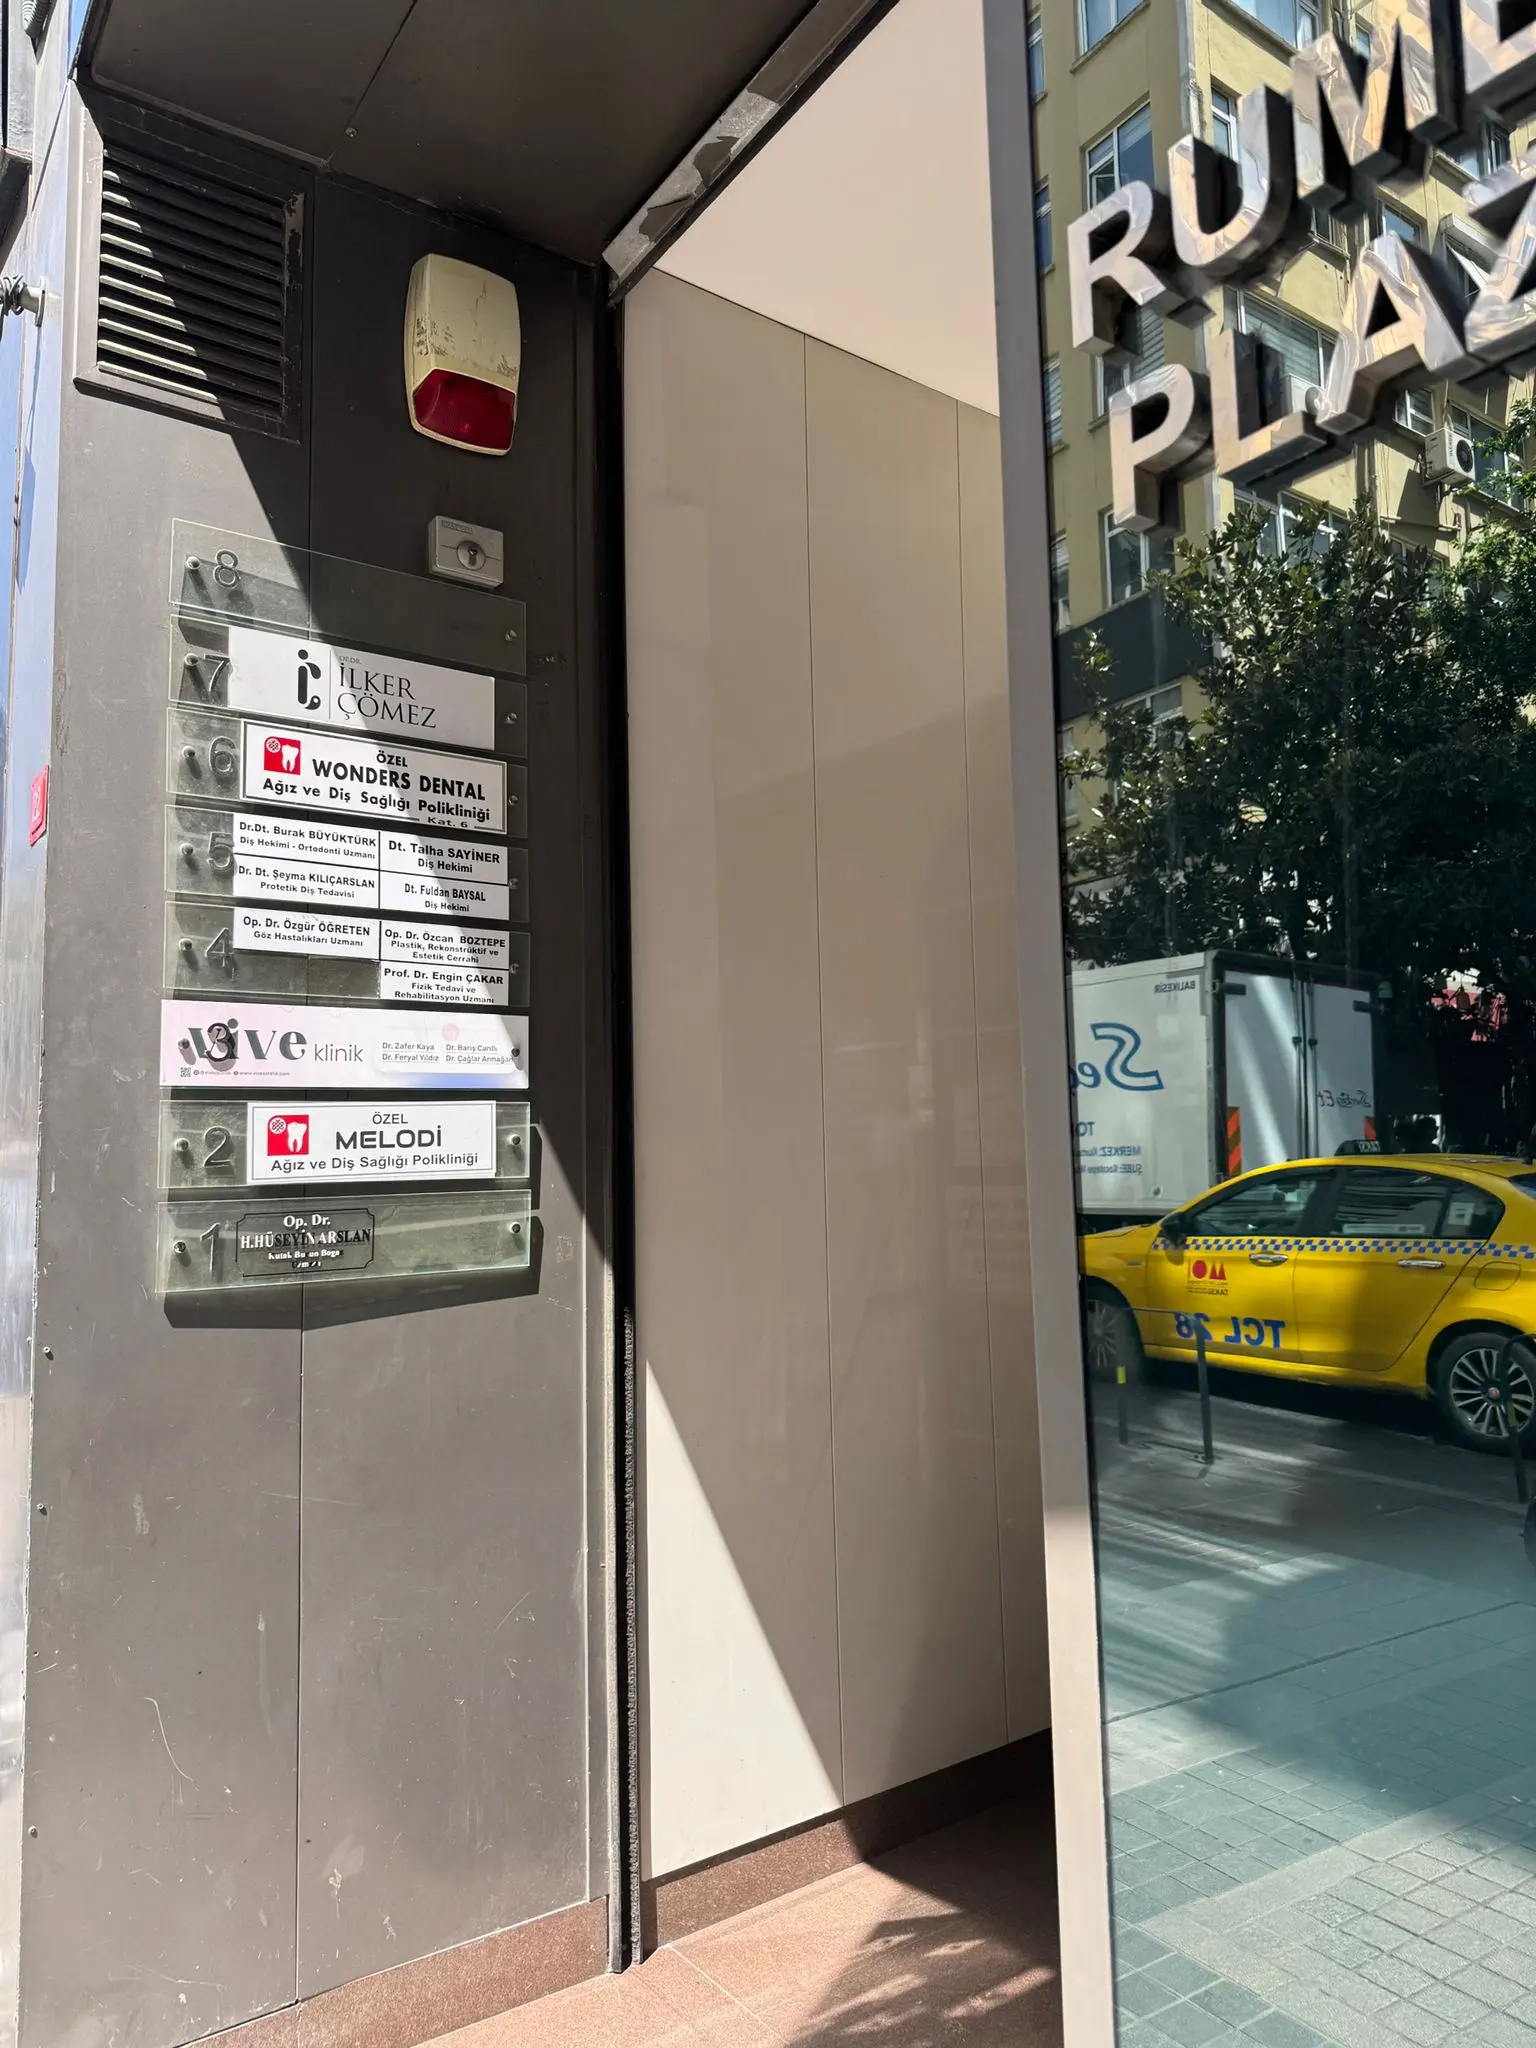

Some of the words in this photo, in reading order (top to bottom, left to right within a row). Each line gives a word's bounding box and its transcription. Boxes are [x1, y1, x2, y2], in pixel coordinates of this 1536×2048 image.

[213, 549, 241, 589] 8
[204, 653, 233, 693] 7
[340, 662, 416, 700] İLKER
[338, 692, 436, 728] ÇÖMEZ
[208, 736, 235, 773] 6
[376, 750, 408, 767] ÖZEL
[312, 758, 411, 790] WONDERS
[419, 775, 485, 801] DENTAL
[263, 778, 297, 795] Ağız
[303, 786, 320, 797] ve
[329, 787, 351, 803] Diş
[360, 791, 410, 811] Sağlığı
[418, 799, 490, 822] Polikliniği
[428, 816, 456, 827] Kat.
[239, 822, 270, 834] Dr.Dt.
[274, 826, 305, 838] Burak
[309, 829, 377, 847] BÜYÜKTÜRK
[207, 832, 233, 869] 5
[240, 837, 255, 846] Diş
[257, 838, 290, 849] Hekimi
[298, 843, 341, 856] Ortodonti
[343, 849, 376, 860] Uzmanı
[388, 840, 406, 852] Dt.
[410, 843, 444, 857] Talha
[447, 847, 500, 864] SAYİNER
[418, 858, 434, 870] Diş
[437, 860, 473, 873] Hekimi
[238, 865, 252, 875] Dr.
[255, 867, 270, 877] Dt.
[272, 869, 306, 882] Şeyma
[309, 873, 375, 889] KILIÇARSLAN
[260, 881, 298, 893] Protetik
[300, 885, 315, 896] Diş
[318, 887, 355, 899] Tedavisi
[404, 883, 417, 894] Dt.
[420, 885, 450, 898] Fuldan
[452, 889, 486, 902] BAYSAL
[424, 900, 438, 910] Diş
[440, 902, 470, 912] Hekimi
[243, 916, 261, 928] Op.
[265, 918, 280, 928] Dr.
[283, 919, 315, 934] Özgür
[318, 921, 370, 936] ÖĞRETEN
[205, 927, 235, 967] 4
[253, 931, 272, 940] Göz
[274, 932, 328, 944] Hastalıkları
[330, 937, 364, 947] Uzmanı
[384, 929, 402, 940] Op.
[405, 931, 419, 941] Dr.
[422, 931, 454, 943] Özcan
[459, 936, 506, 948] BOZTEPE
[391, 940, 426, 951] Plastik,
[428, 943, 486, 955] Rekonstrüktif
[412, 952, 444, 961] Estetik
[446, 954, 479, 964] Cerrahi
[384, 968, 410, 979] Prof.
[413, 970, 428, 980] Dr.
[432, 972, 462, 983] Engin
[465, 973, 504, 985] ÇAKAR
[411, 982, 433, 991] Fizik
[435, 984, 464, 993] Tedavi
[394, 991, 460, 1002] Rehabilitasyon
[462, 994, 494, 1004] Uzmanı
[314, 1043, 363, 1062] klinik
[394, 1042, 415, 1050] Zafer
[417, 1043, 434, 1051] Kaya
[394, 1054, 418, 1062] Feryal
[457, 1055, 480, 1063] Çağlar
[481, 1056, 513, 1064] Armağan
[372, 1111, 408, 1125] ÖZEL
[204, 1126, 232, 1168] 2
[335, 1125, 442, 1150] MELODİ
[271, 1159, 305, 1173] Ağız
[310, 1161, 326, 1169] ve
[332, 1157, 354, 1171] Diş
[360, 1156, 408, 1170] Sağlığı
[412, 1152, 478, 1167] Polikliniği
[283, 1215, 307, 1229] Op.
[311, 1214, 331, 1226] Dr.
[318, 1229, 371, 1245] ARSLAN
[200, 1222, 220, 1277] 1
